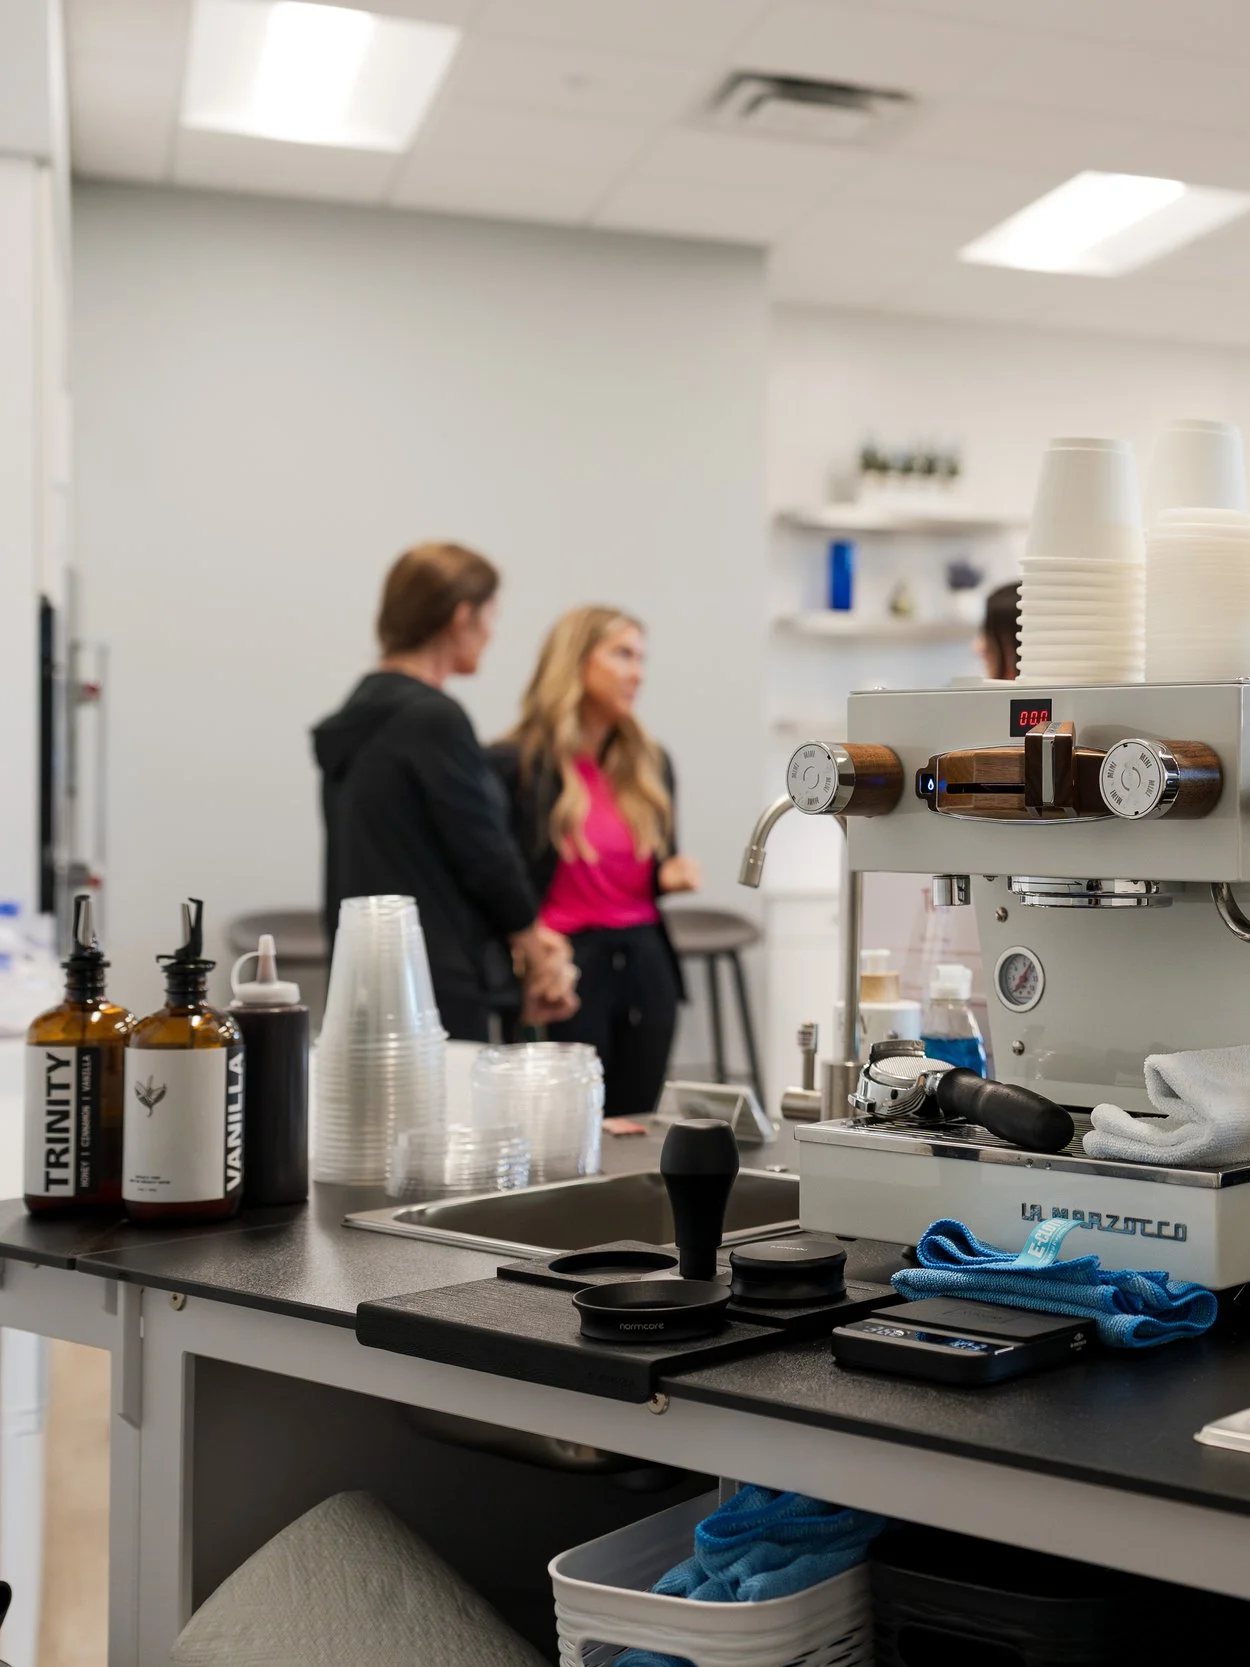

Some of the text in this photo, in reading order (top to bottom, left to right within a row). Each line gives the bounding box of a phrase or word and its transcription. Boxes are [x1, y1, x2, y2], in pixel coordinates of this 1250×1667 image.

[1107, 760, 1118, 778] MINI
[1140, 752, 1152, 768] MINI
[1110, 788, 1123, 806] MINI
[82, 1054, 92, 1092] VANILLA
[44, 1052, 70, 1192] TRINITY
[80, 1105, 90, 1148] CINNAMON
[226, 1052, 244, 1192] VANILLA
[80, 1160, 90, 1188] HONEY
[619, 1322, 664, 1330] normcore
